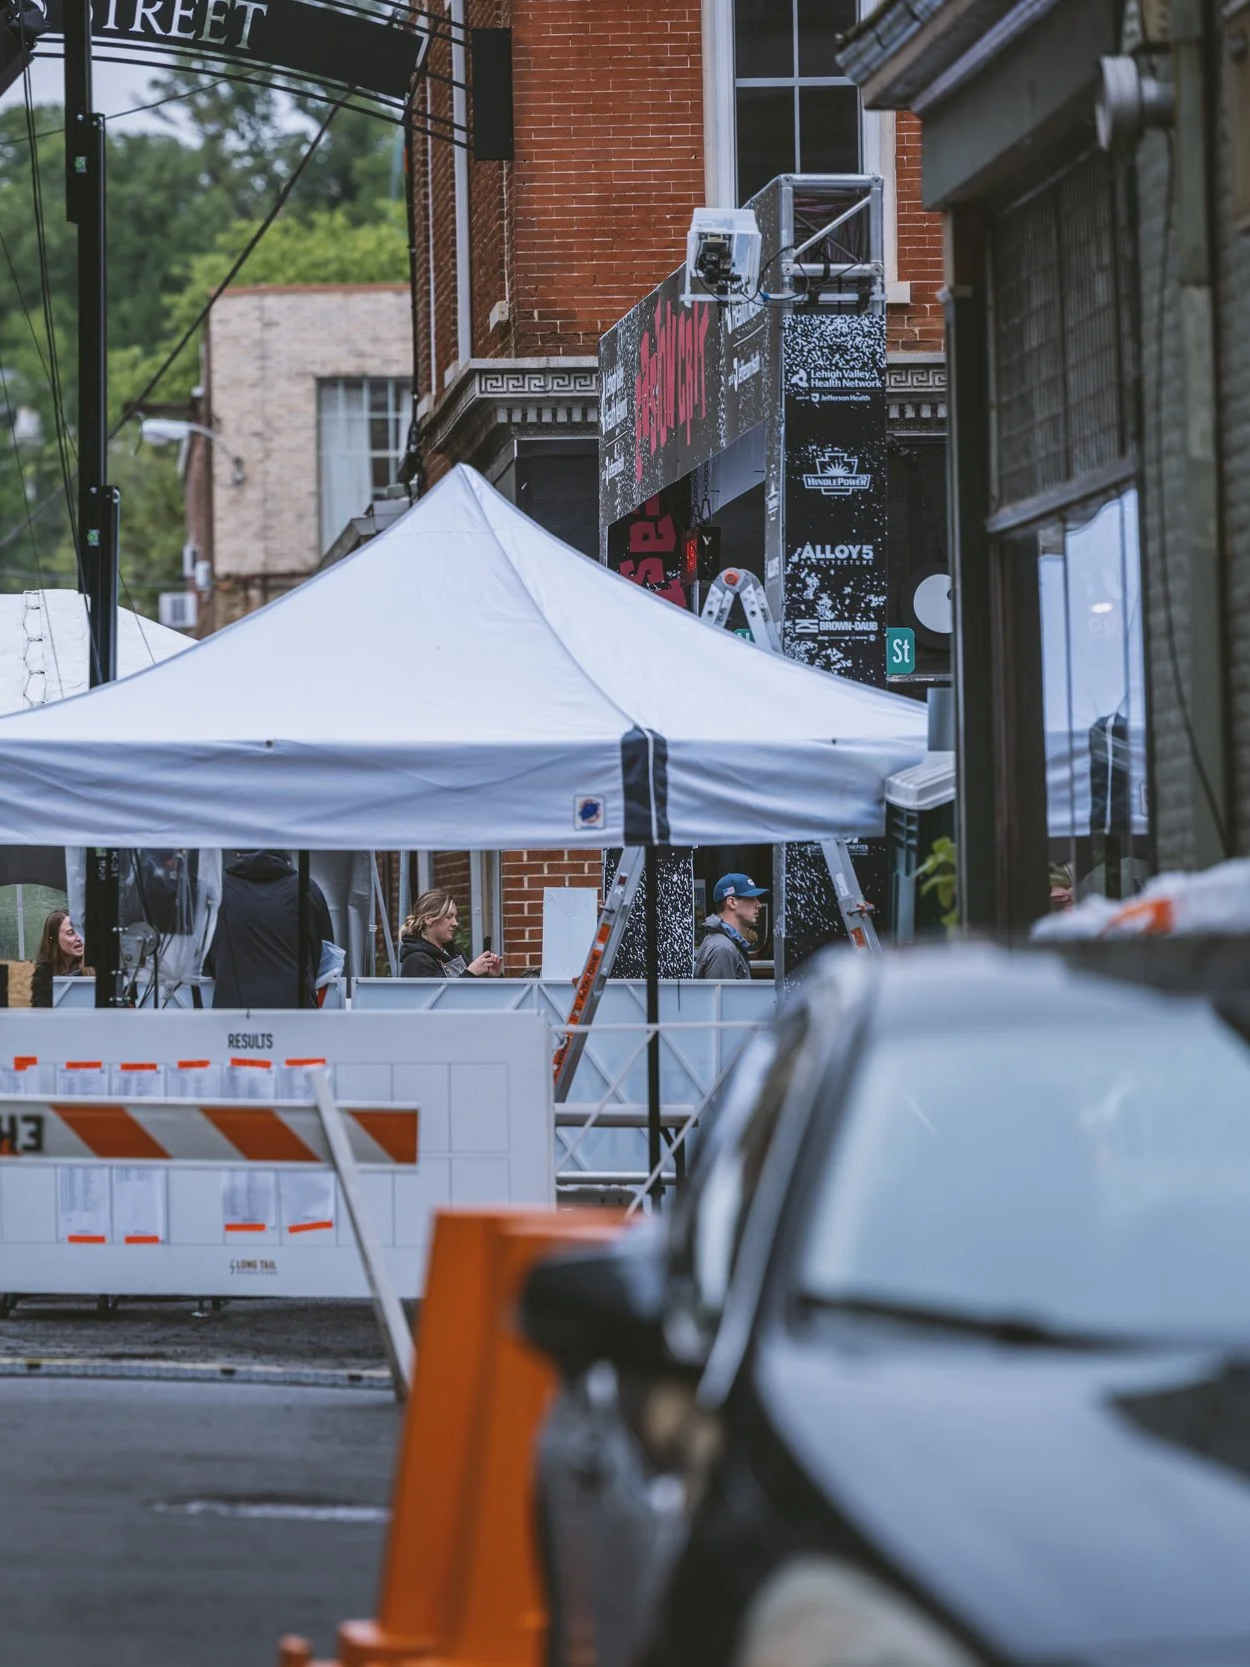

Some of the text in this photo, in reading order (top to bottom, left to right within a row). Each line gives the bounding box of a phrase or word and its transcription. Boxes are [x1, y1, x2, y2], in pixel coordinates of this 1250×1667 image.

[88, 0, 268, 50] TREET
[810, 369, 871, 379] Lehigh Valley
[810, 379, 883, 388] Health Network
[800, 544, 874, 560] ALLOY5
[819, 621, 878, 631] BROWN-DAUB
[892, 638, 910, 664] St
[227, 1033, 274, 1050] RESULTS
